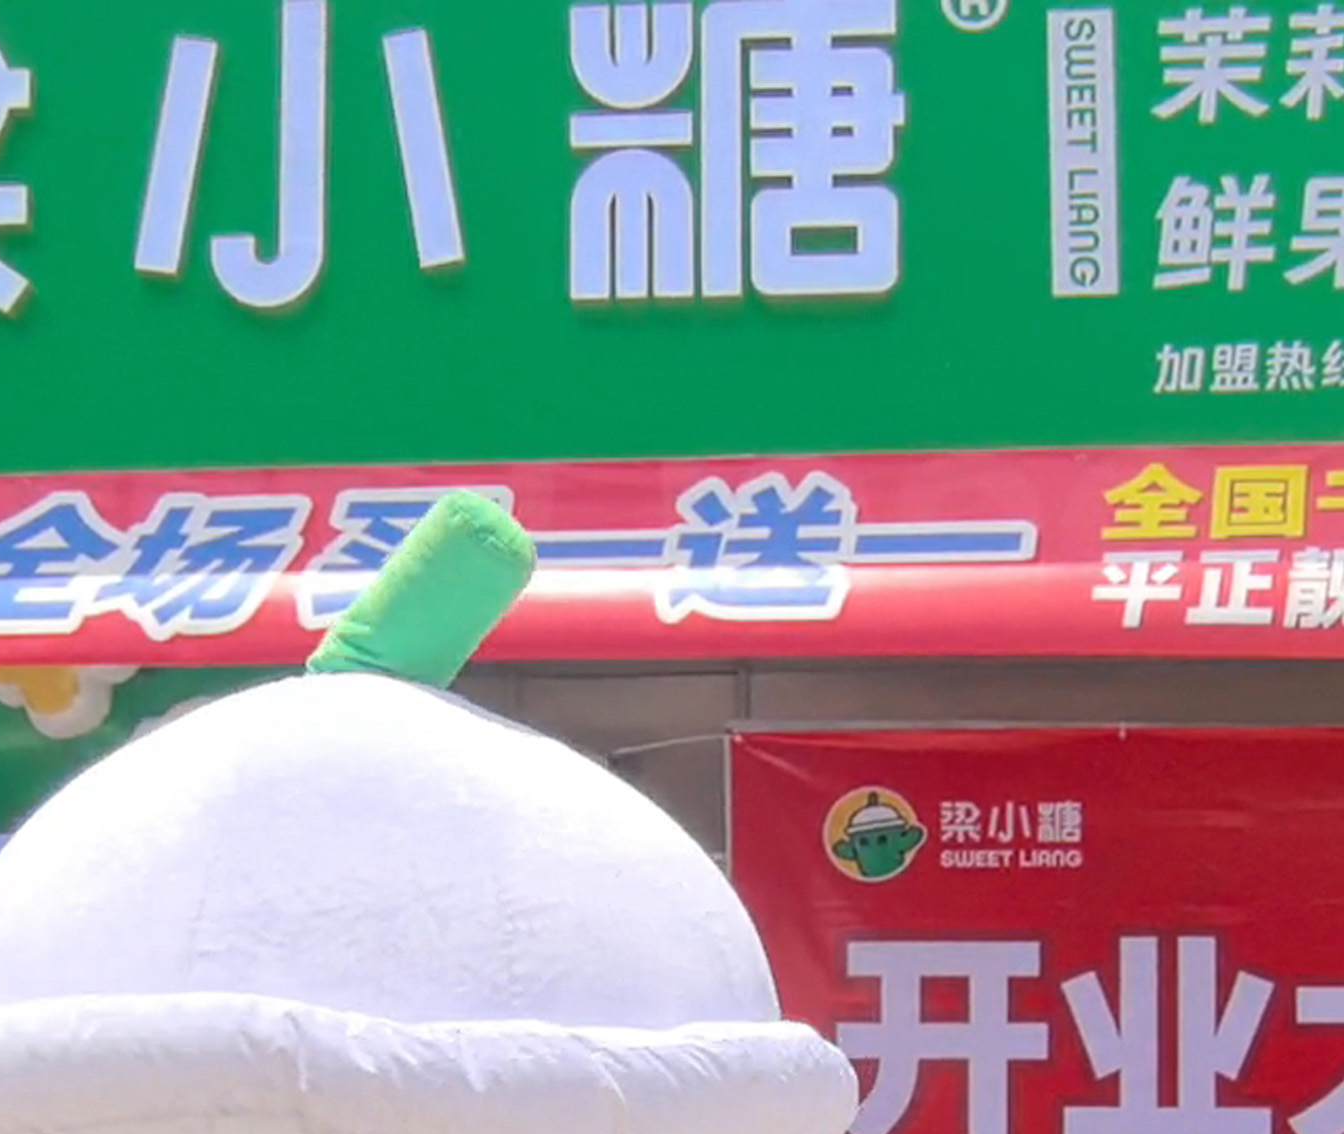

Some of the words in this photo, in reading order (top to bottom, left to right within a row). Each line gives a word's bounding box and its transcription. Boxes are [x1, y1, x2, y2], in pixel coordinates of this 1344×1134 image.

[1063, 18, 1100, 154] SWEET
[1067, 171, 1103, 287] LIANG
[940, 800, 1083, 844] 梁小糖
[940, 849, 1012, 868] SWEET
[1020, 849, 1083, 868] LIANG
